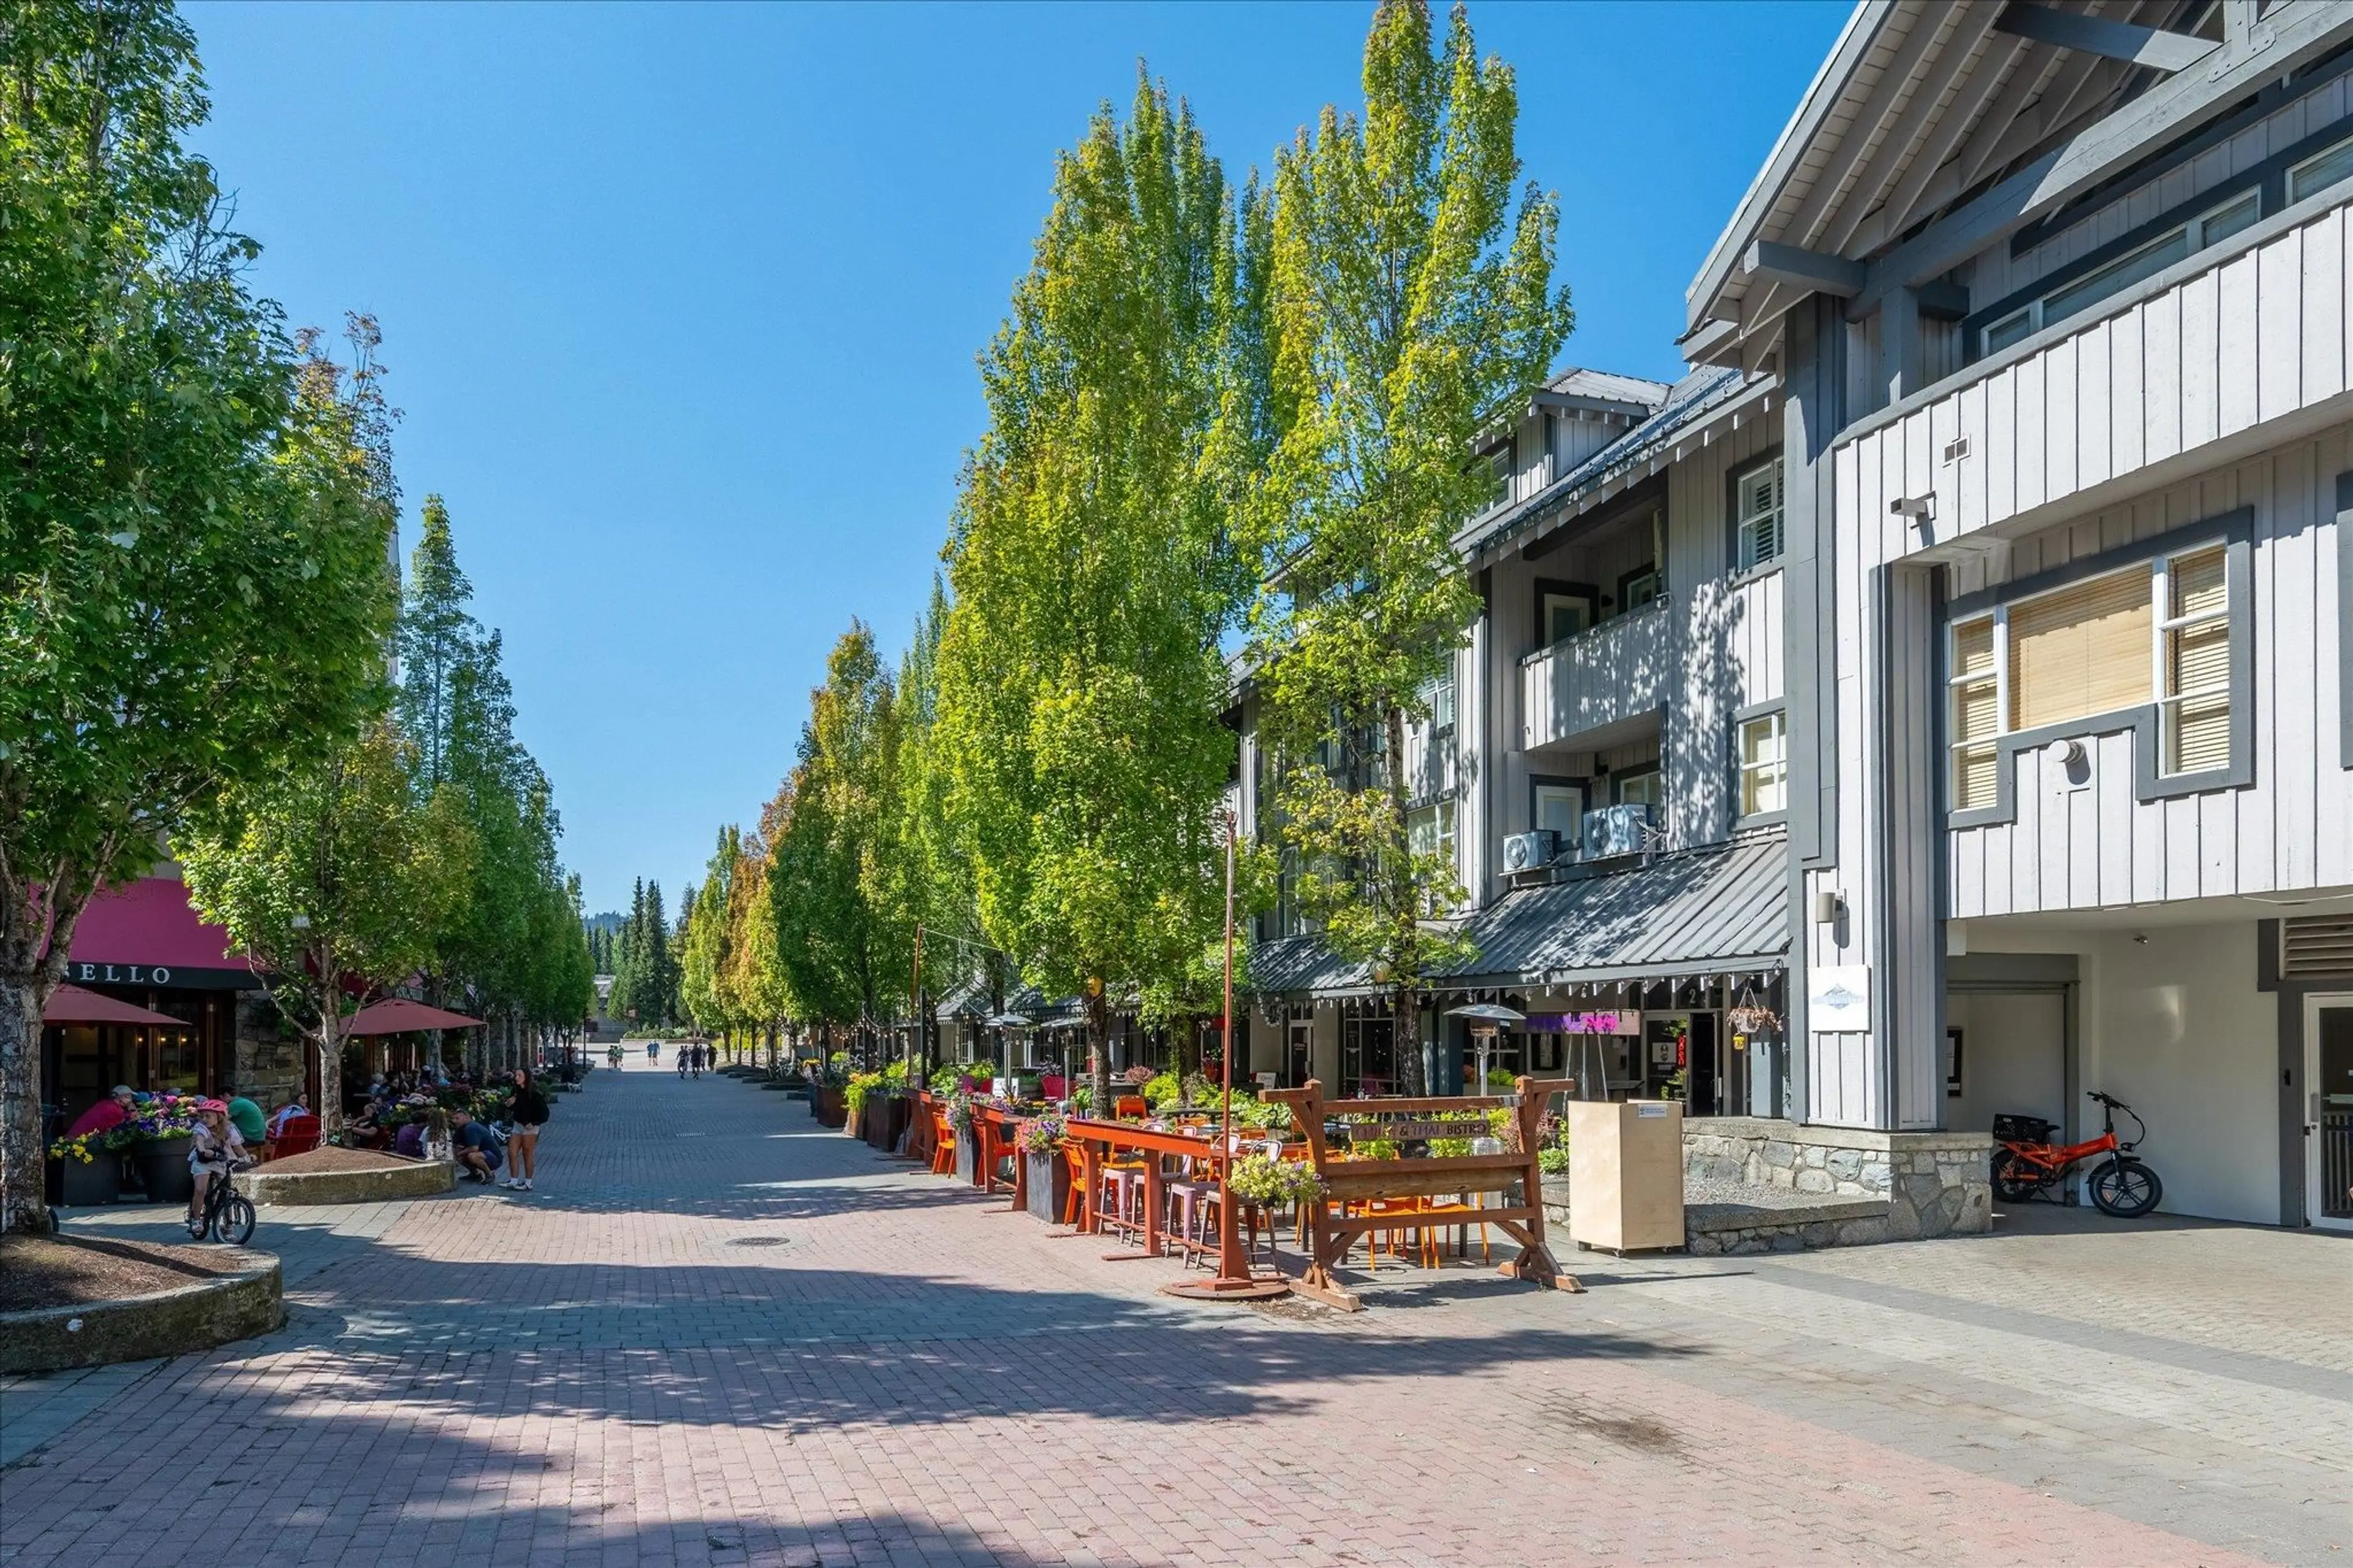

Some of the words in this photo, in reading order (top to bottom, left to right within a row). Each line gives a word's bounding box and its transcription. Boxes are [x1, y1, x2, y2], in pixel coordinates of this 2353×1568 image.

[1689, 988, 1696, 1004] 2
[1400, 1126, 1409, 1137] &
[1447, 1123, 1487, 1135] BISTRO
